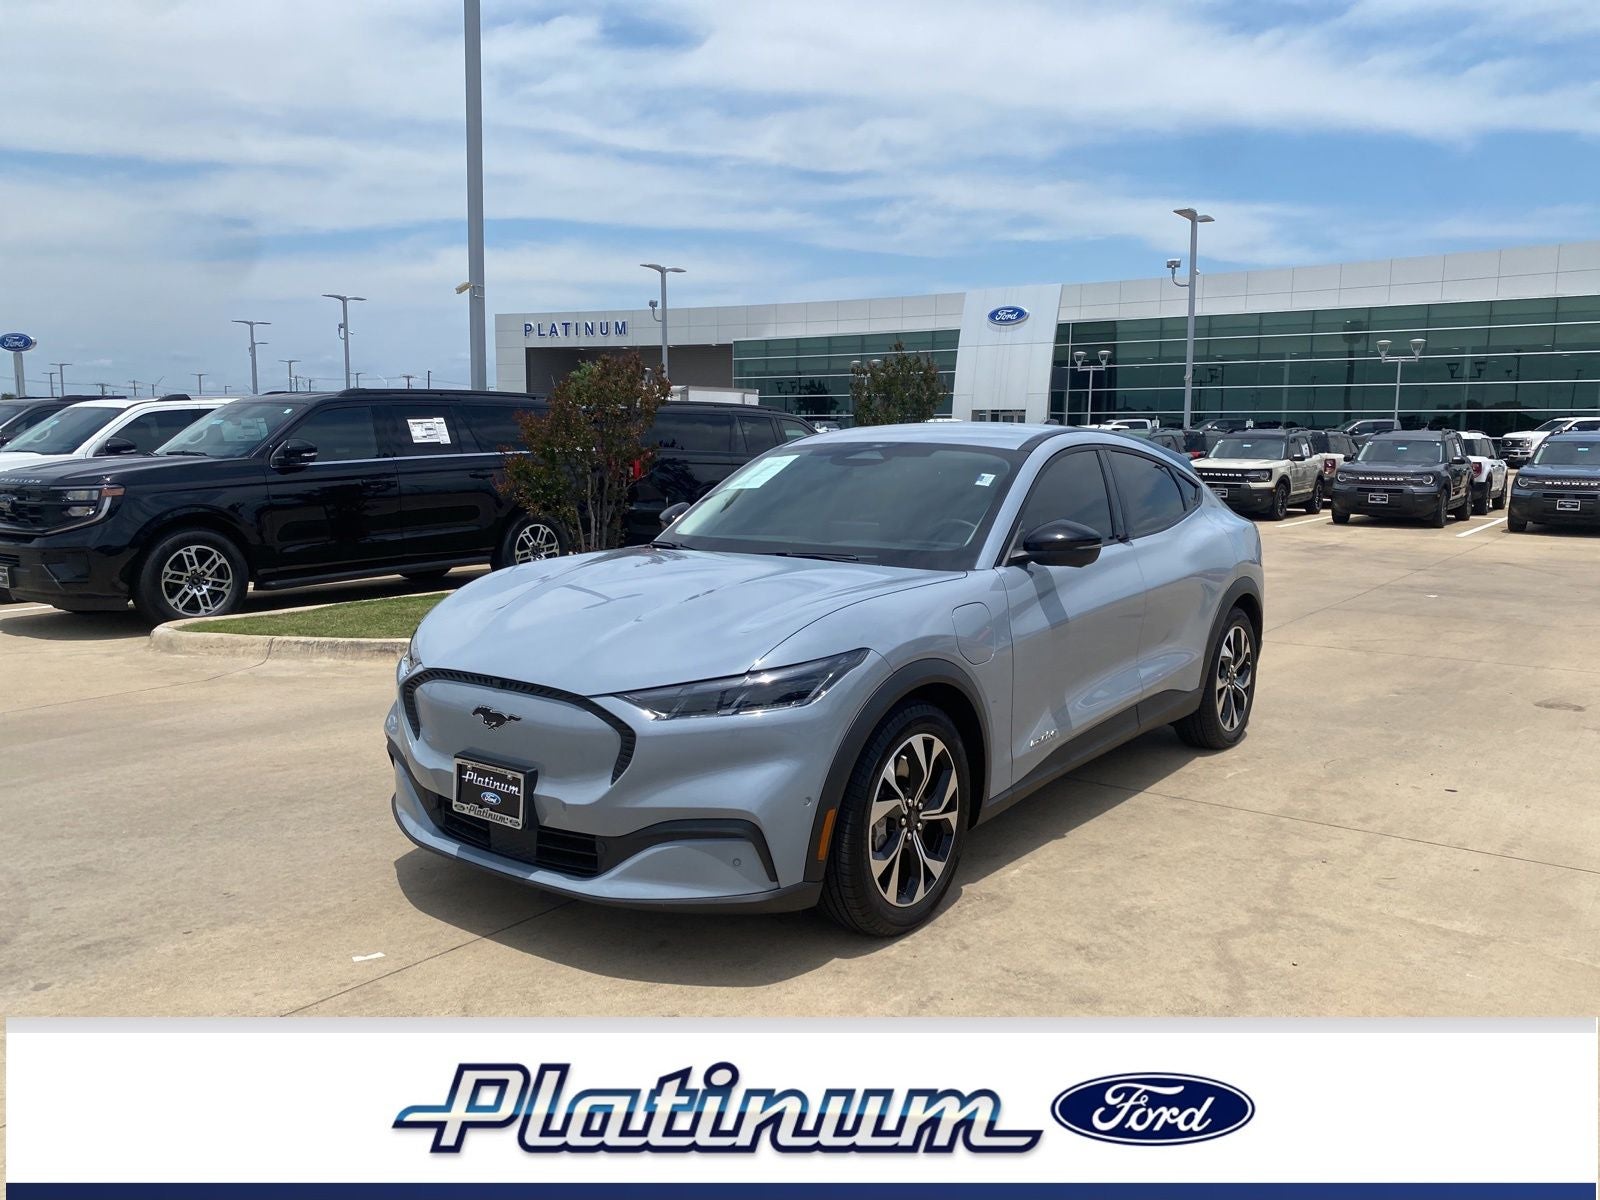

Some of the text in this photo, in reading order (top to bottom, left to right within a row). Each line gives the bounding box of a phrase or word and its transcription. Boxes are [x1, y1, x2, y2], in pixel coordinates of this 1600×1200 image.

[995, 309, 1019, 321] Ford
[524, 320, 627, 337] PLATINUM
[3, 336, 25, 348] Ford
[461, 770, 521, 796] Platinum
[466, 803, 511, 825] Platinum
